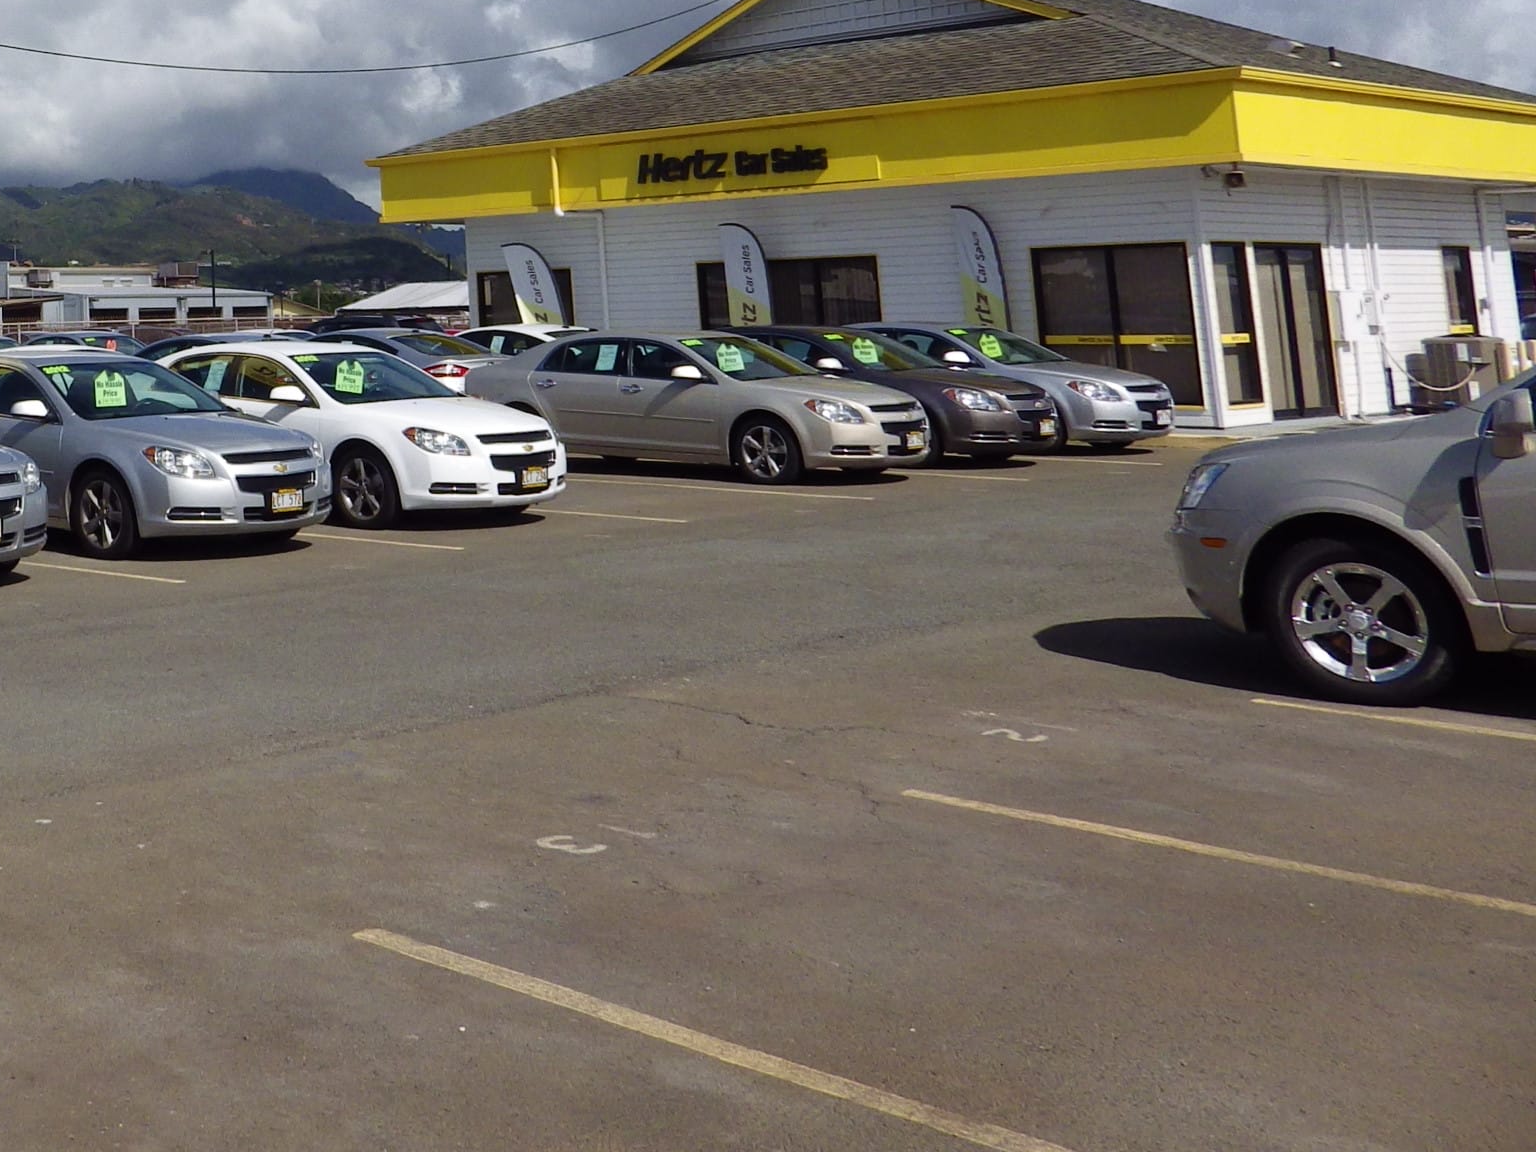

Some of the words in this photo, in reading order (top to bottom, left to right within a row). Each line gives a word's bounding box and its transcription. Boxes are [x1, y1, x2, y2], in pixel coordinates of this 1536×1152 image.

[637, 149, 728, 184] Hertz
[734, 151, 769, 176] Car
[771, 145, 828, 173] Sales
[741, 244, 753, 273] Sales
[525, 259, 540, 285] Sales
[977, 264, 987, 283] Car
[744, 275, 755, 294] Car
[533, 288, 544, 304] Car
